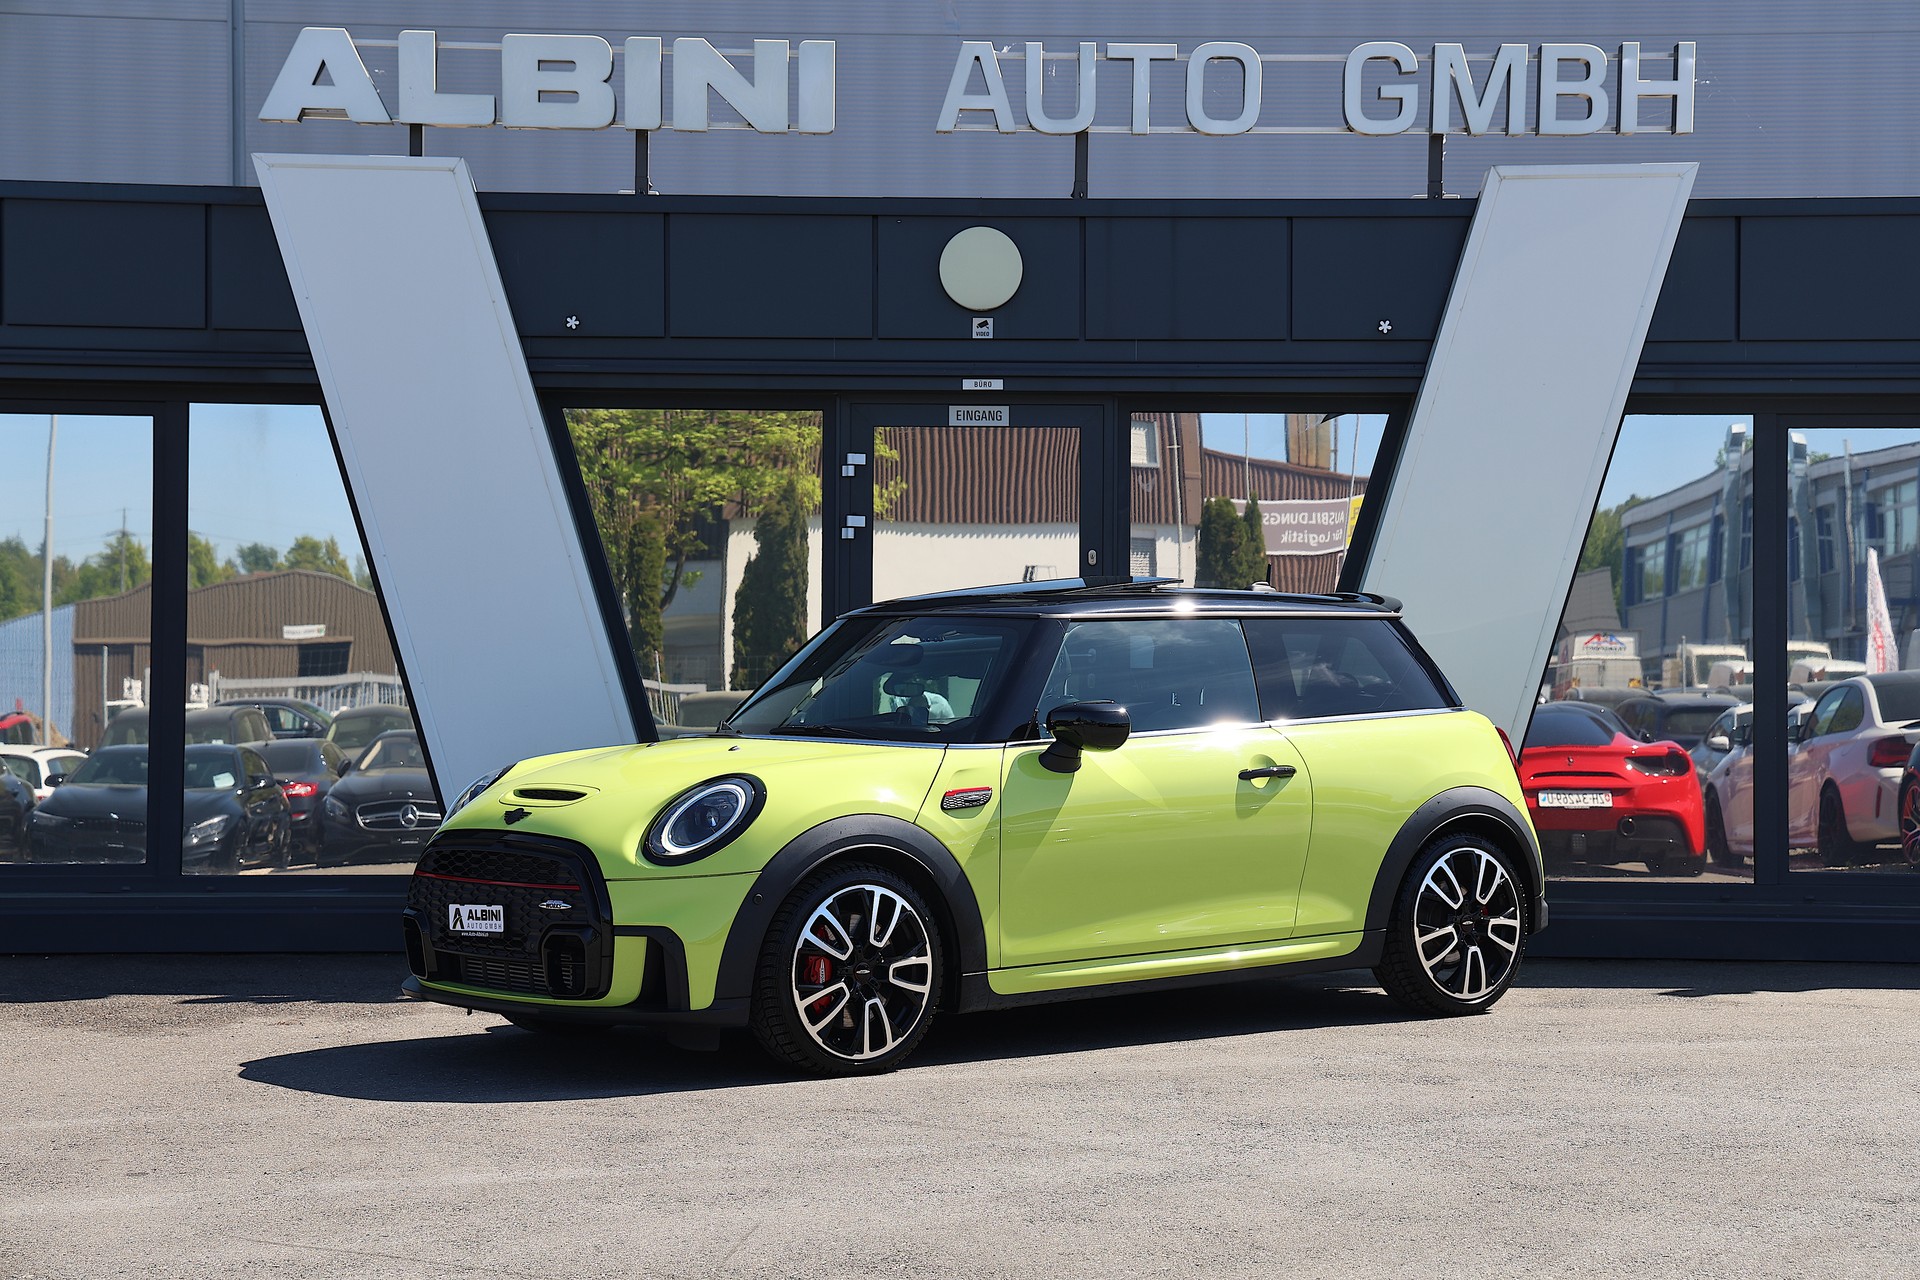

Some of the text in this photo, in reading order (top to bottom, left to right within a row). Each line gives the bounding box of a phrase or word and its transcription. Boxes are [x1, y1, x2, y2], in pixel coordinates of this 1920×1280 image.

[258, 27, 1697, 136] ALBINI AUTO GMBH
[974, 380, 992, 388] BÜRO
[956, 410, 1003, 421] EINGANG
[467, 909, 501, 921] ALBINI
[484, 922, 502, 930] GMBH
